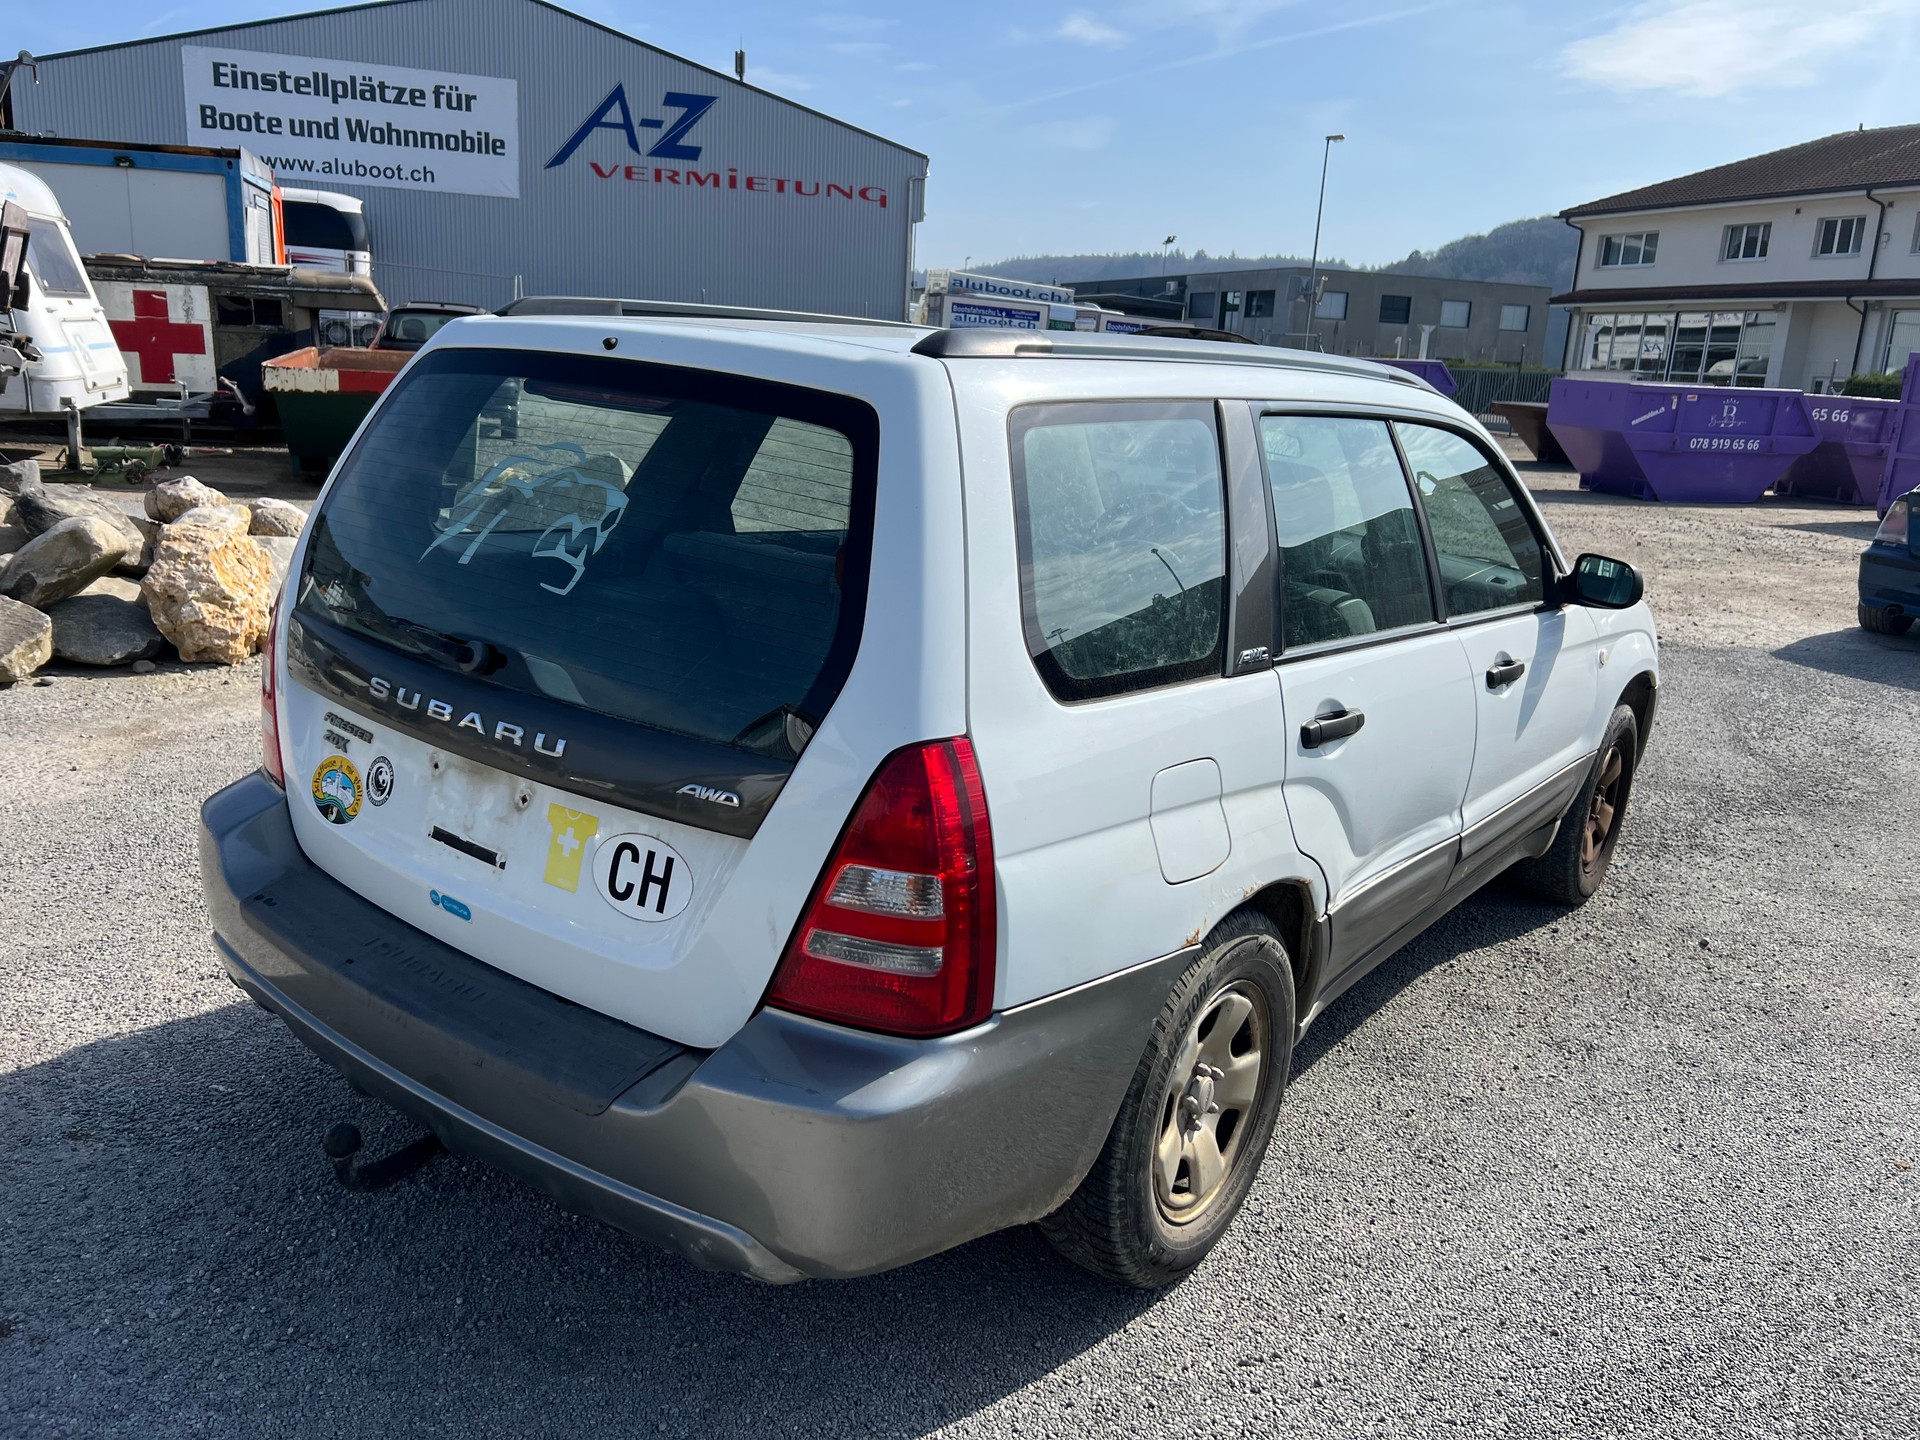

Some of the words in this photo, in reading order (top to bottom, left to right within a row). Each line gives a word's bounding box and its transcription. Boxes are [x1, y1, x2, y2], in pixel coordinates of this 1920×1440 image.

[212, 61, 426, 104] Einstellplätze
[432, 84, 477, 112] für
[200, 104, 283, 135] Boote
[289, 117, 340, 140] und
[345, 117, 506, 156] Wohnmobile
[544, 80, 720, 170] A-Z
[260, 155, 435, 183] www.aluboot.ch
[952, 278, 1063, 302] aluboot.ch
[954, 314, 1036, 330] aluboot.ch
[1812, 408, 1828, 421] 65
[1831, 409, 1849, 423] 66
[1690, 438, 1708, 449] 078
[1711, 438, 1730, 449] 919
[1732, 439, 1745, 450] 65
[1747, 440, 1759, 450] 66
[324, 711, 374, 744] FORESTER
[369, 676, 567, 757] SUBARU
[676, 783, 741, 807] AWD
[608, 841, 675, 914] CH
